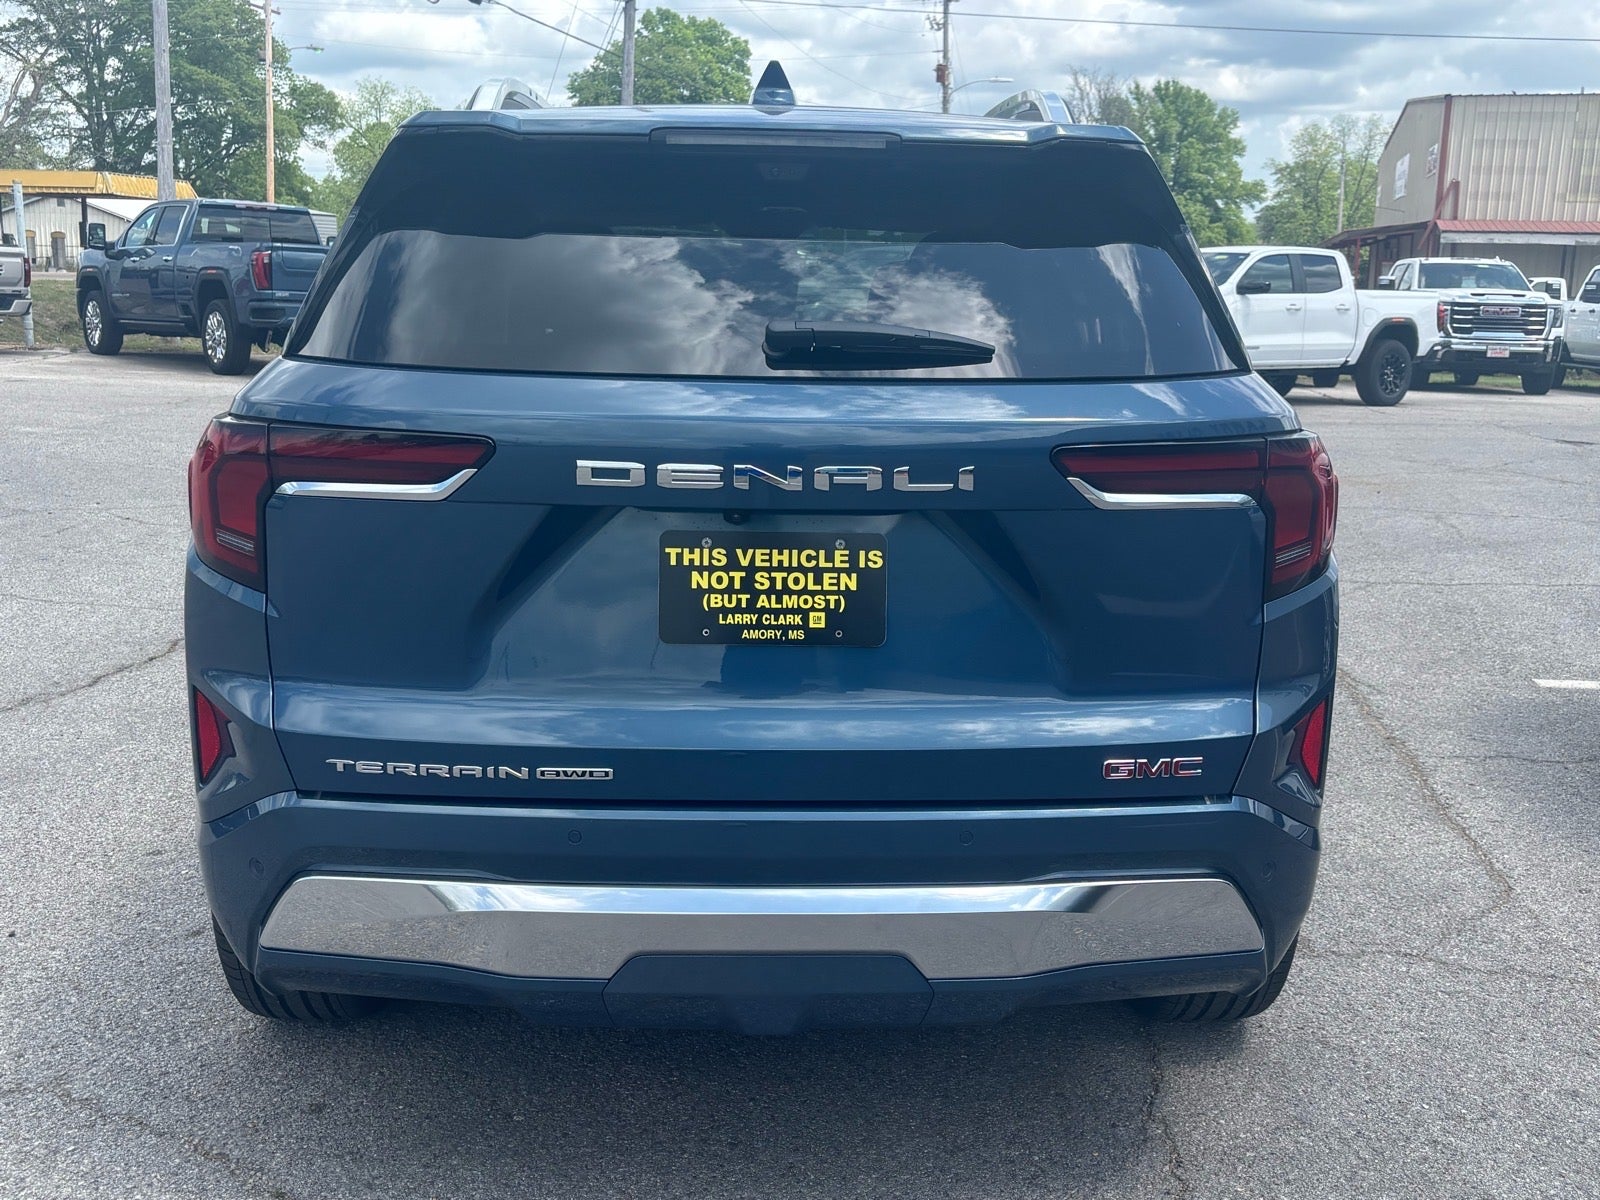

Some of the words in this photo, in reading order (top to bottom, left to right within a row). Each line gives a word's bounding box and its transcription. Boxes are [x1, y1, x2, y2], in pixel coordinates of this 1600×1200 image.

[576, 460, 975, 491] DENALI
[665, 548, 728, 567] THIS
[735, 549, 850, 568] VEHICLE
[859, 550, 884, 568] IS
[691, 571, 746, 590] NOT
[754, 572, 857, 591] STOLEN
[702, 593, 750, 611] (BUT
[756, 595, 846, 613] ALMOST)
[719, 613, 758, 625] LARRY
[762, 614, 803, 625] CLARK
[741, 629, 786, 640] AMORY,
[788, 629, 805, 640] MS
[326, 758, 529, 780] TERRAIN
[537, 768, 612, 779] AWD
[1103, 757, 1203, 779] GMC
